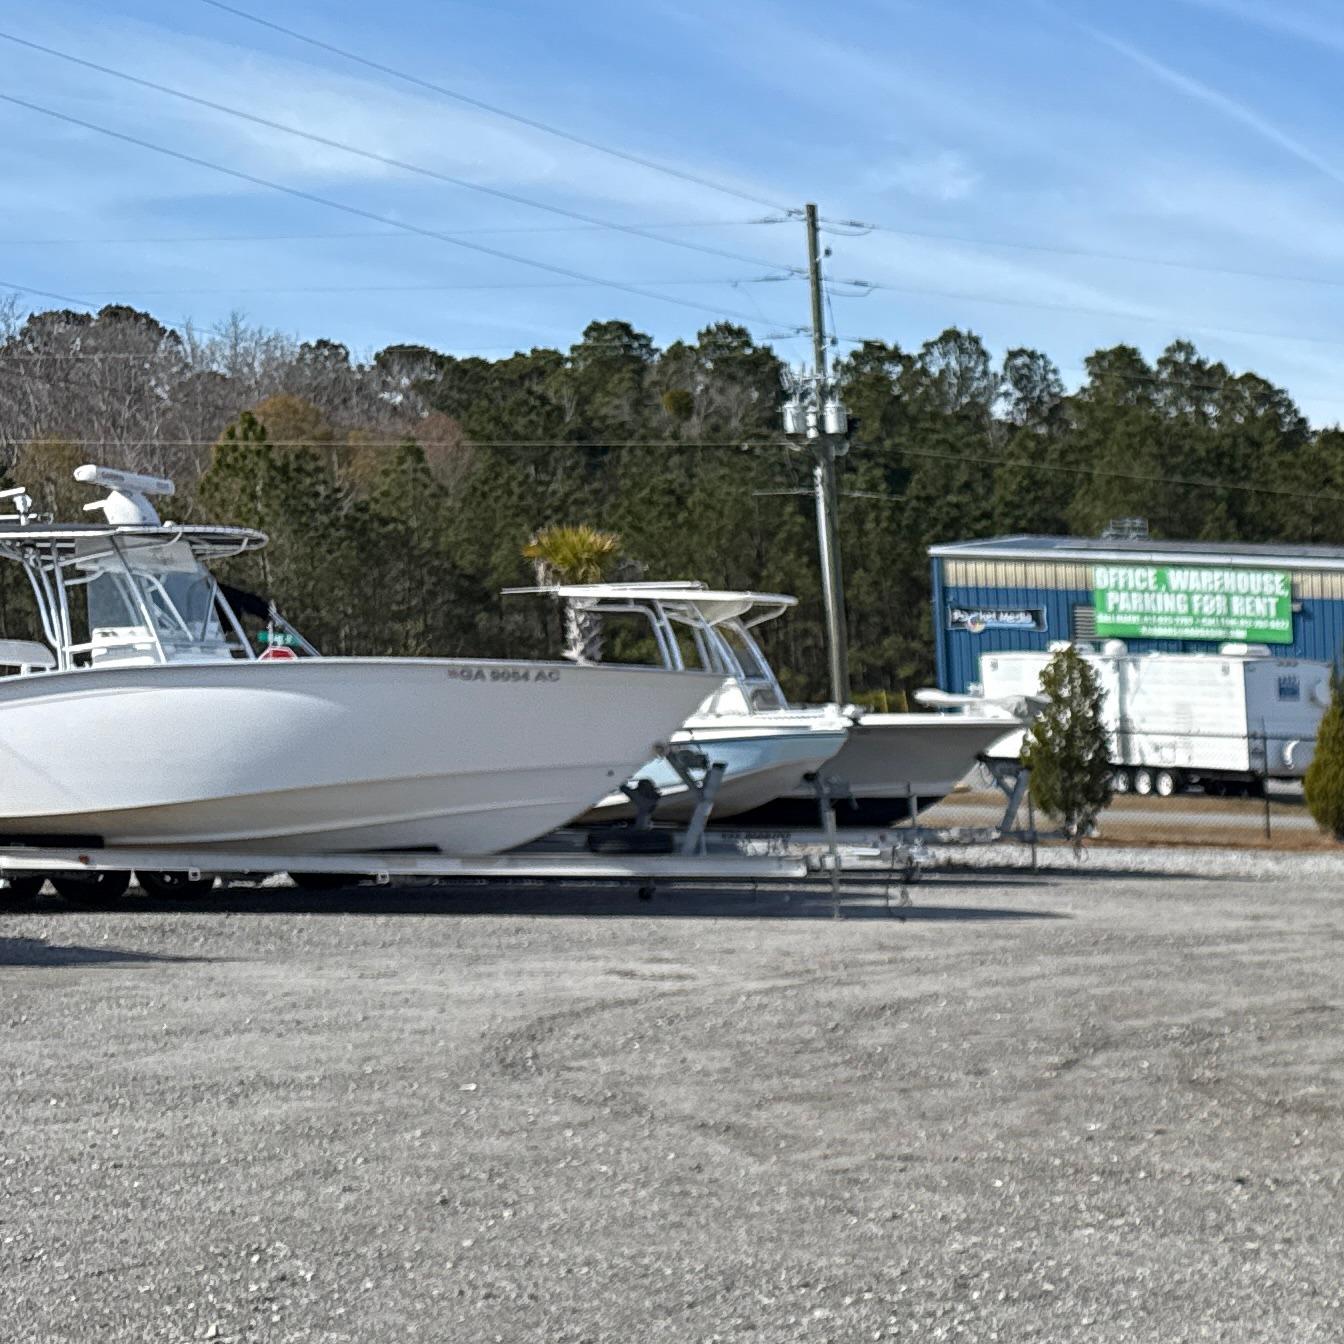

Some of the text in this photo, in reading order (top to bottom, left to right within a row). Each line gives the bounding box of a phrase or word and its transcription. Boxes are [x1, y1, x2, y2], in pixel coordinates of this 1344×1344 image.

[1107, 591, 1279, 617] PARKING FOR RENT
[534, 670, 560, 683] AC
